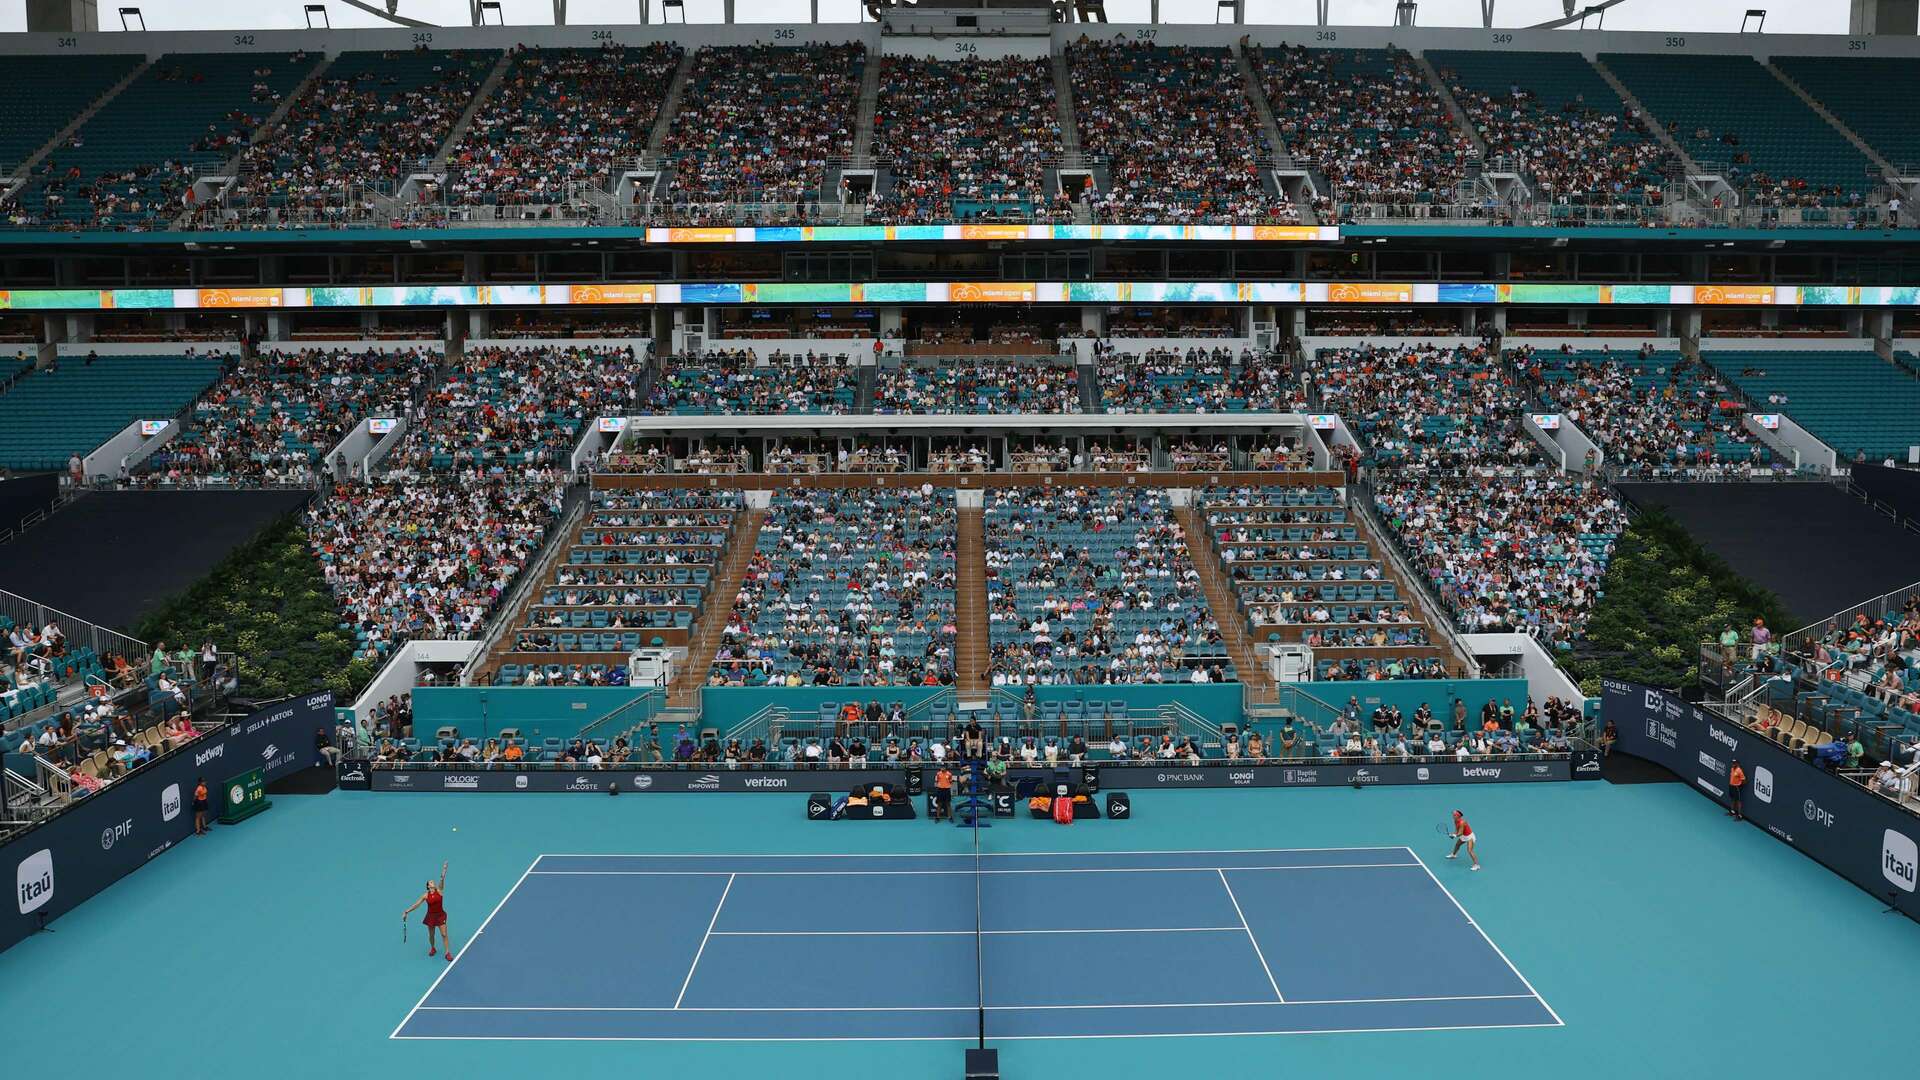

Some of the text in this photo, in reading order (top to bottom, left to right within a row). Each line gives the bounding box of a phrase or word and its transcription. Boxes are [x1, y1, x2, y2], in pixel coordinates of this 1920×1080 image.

[412, 32, 432, 43] 343
[592, 30, 612, 40] 344
[774, 29, 795, 39] 345
[1137, 29, 1158, 39] 347
[1316, 31, 1336, 41] 348
[1492, 33, 1512, 43] 349
[58, 38, 77, 48] 341
[233, 35, 255, 46] 342
[1666, 37, 1685, 47] 350
[1848, 40, 1867, 50] 351
[955, 43, 977, 53] 346
[1604, 680, 1632, 692] DOBEL
[311, 703, 328, 711] SOLAR
[246, 709, 294, 735] STELLA ARTOIS
[1709, 724, 1739, 752] betway
[195, 743, 225, 767] betway
[1166, 774, 1204, 782] PNC BANK
[1297, 769, 1317, 778] Baptist
[1462, 767, 1501, 779] betway
[444, 775, 479, 783] HOLOGIC
[745, 776, 787, 788] verizon
[1755, 778, 1771, 797] itaú
[163, 796, 180, 816] itaú
[1817, 808, 1835, 828] PIF
[115, 818, 133, 841] PIF
[1885, 848, 1914, 883] itaú
[21, 871, 51, 904] itaú
